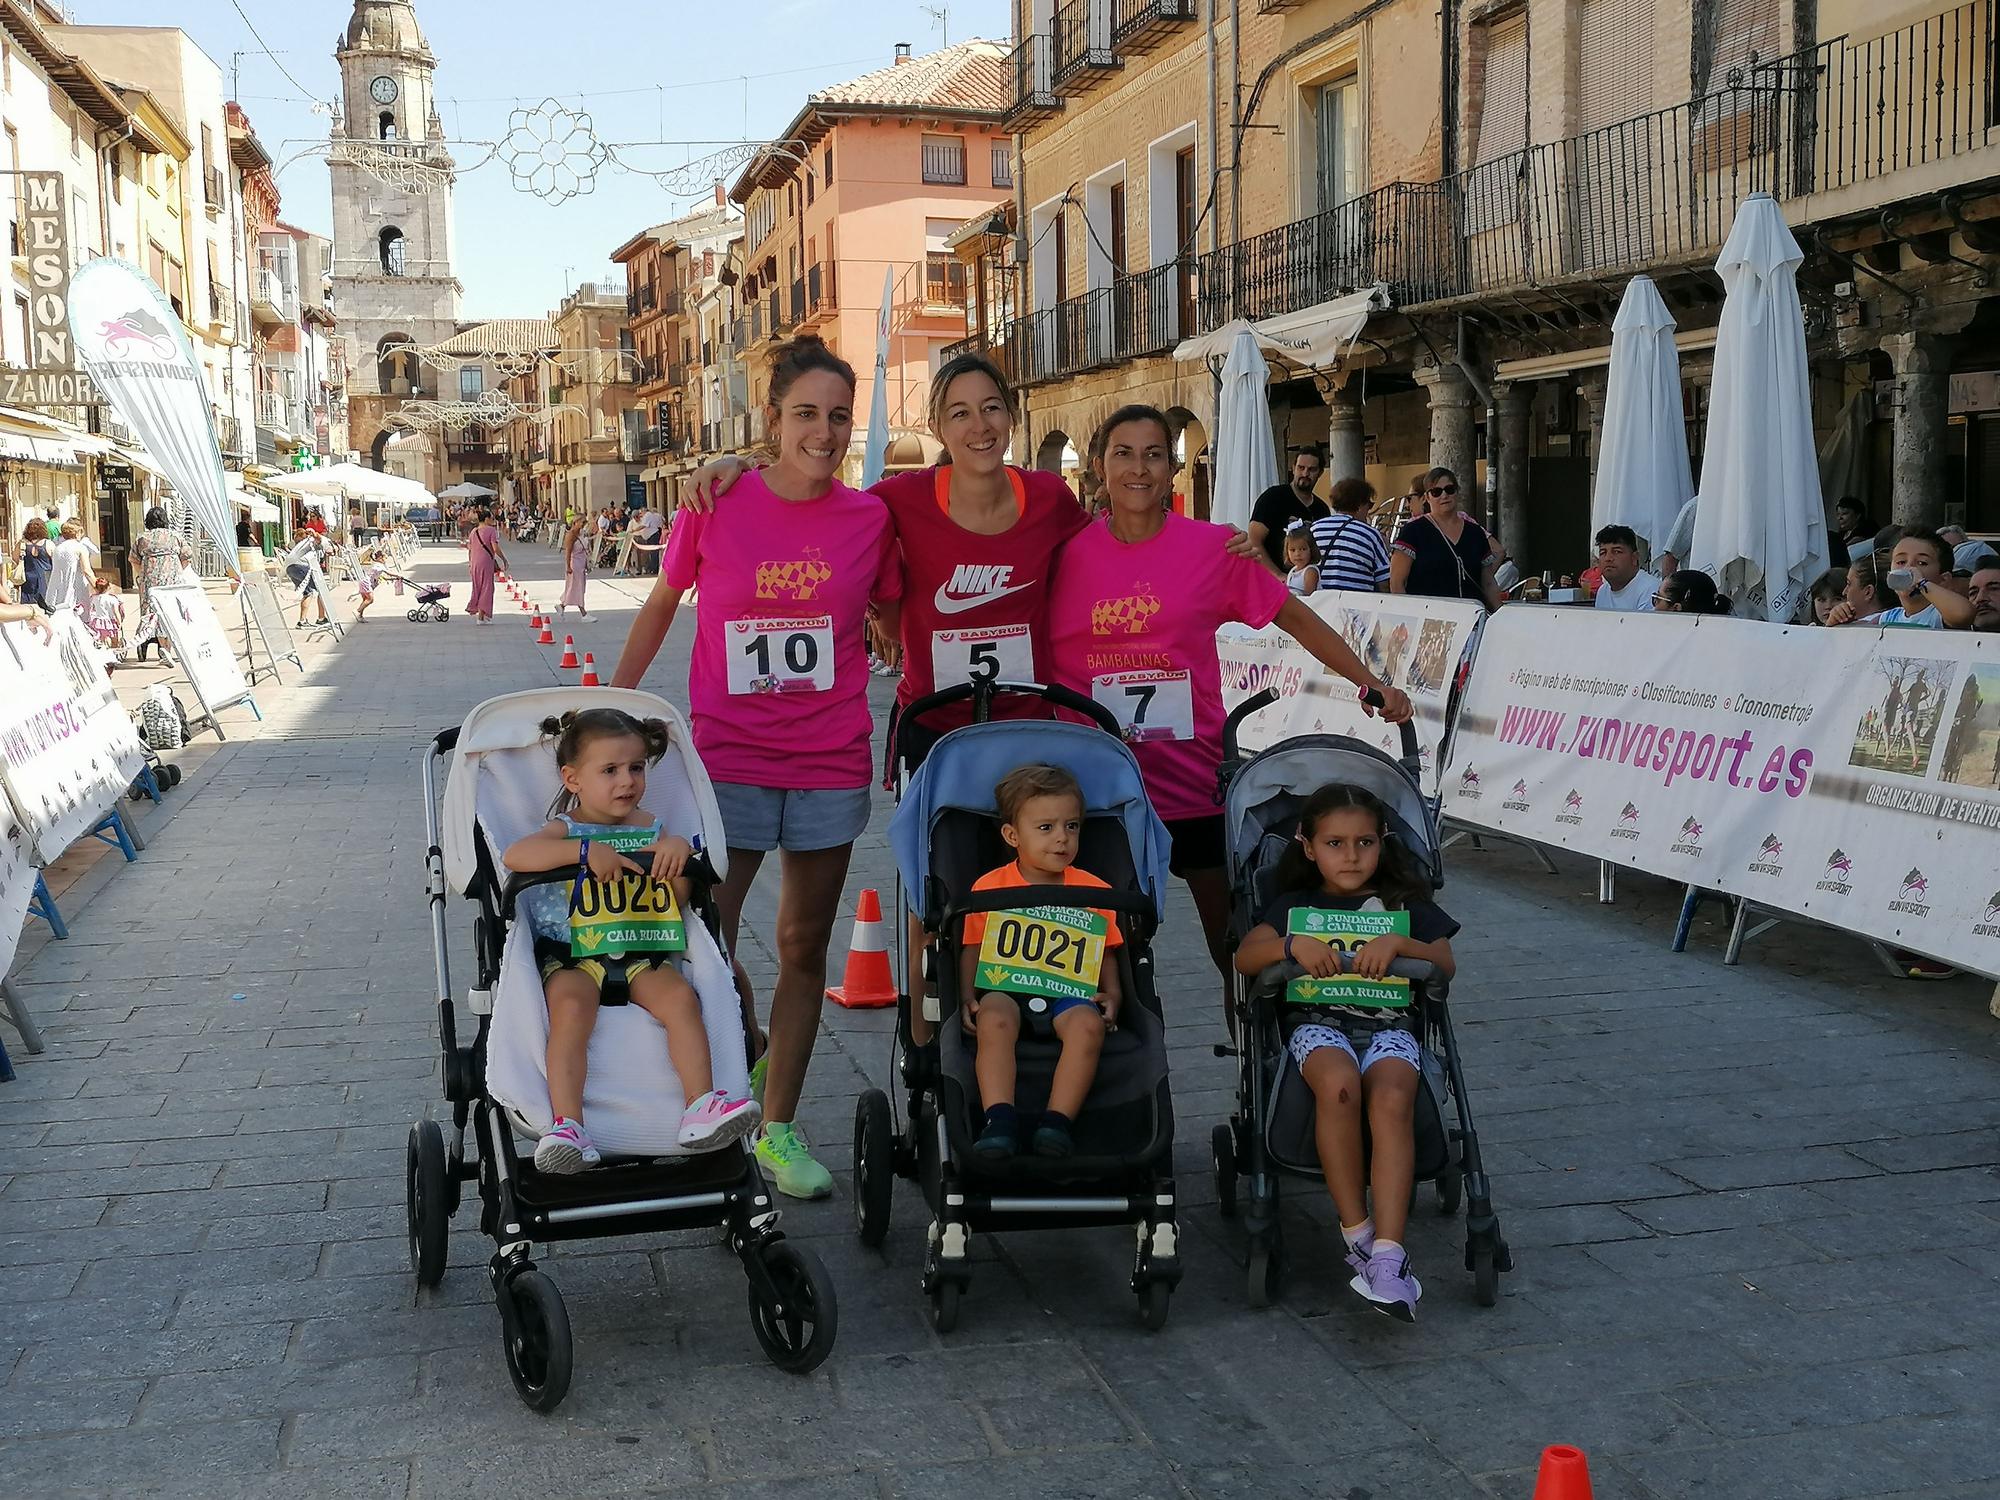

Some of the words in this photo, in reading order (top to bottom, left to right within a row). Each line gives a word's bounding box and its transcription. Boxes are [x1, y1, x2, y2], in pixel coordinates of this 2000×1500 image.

[28, 178, 67, 365] MESON
[946, 564, 1014, 593] NIKE
[755, 618, 829, 632] BABYRUN
[959, 625, 1028, 641] BABYRUN
[745, 632, 818, 675] 10
[968, 641, 1000, 682] 5
[1087, 653, 1171, 669] BAMBALINAS
[1118, 671, 1188, 684] BABYRUN
[1515, 668, 1542, 688] Página
[1542, 673, 1560, 688] web
[1560, 674, 1572, 690] de
[1571, 676, 1628, 697] inscripciones
[1125, 685, 1156, 724] 7
[1641, 681, 1717, 709] Clasificaciones
[1734, 693, 1814, 726] Cronometraje
[1499, 704, 1814, 798] www.runvasport.es
[1939, 798, 1959, 819] DE
[574, 873, 671, 917] 0025
[1026, 908, 1052, 920] CAJA
[1056, 914, 1091, 930] RURAL
[1327, 914, 1394, 926] FUNDACION
[1327, 924, 1354, 932] CAJA
[1356, 925, 1392, 934] RURAL
[606, 930, 638, 942] CAJA
[640, 929, 679, 941] RURAL
[997, 919, 1087, 974] 0021
[1011, 973, 1044, 988] CAJA
[1045, 978, 1090, 1000] RURAL
[1321, 986, 1355, 997] CAJA
[1356, 987, 1402, 1000] RURAL
